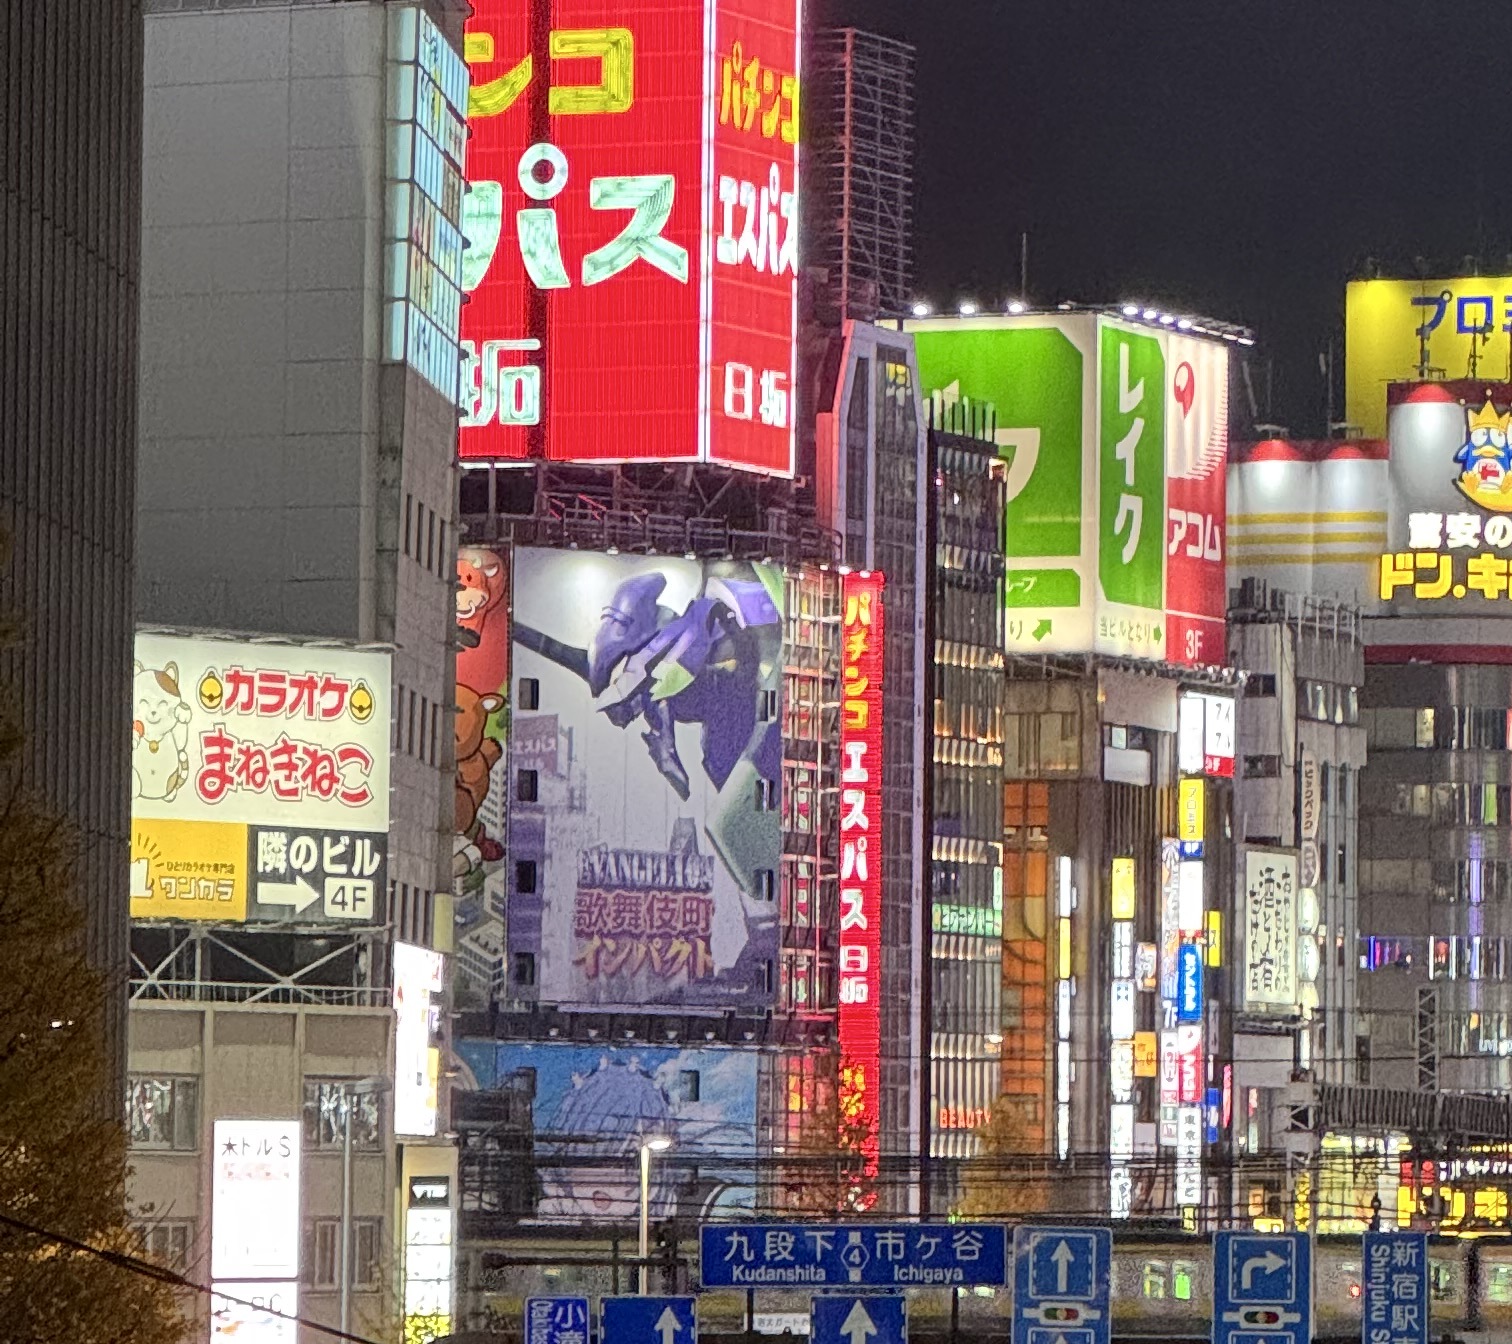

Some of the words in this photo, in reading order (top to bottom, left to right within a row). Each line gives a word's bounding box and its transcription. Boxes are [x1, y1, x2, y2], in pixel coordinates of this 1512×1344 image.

[720, 41, 799, 144] パチンコ
[716, 161, 799, 276] エスパス
[724, 361, 787, 428] 日拓
[1113, 342, 1146, 565] レイク
[1168, 507, 1222, 562] アコム
[842, 587, 875, 730] パチンコ
[1185, 629, 1204, 659] 3F
[222, 665, 349, 719] カラオケ
[198, 727, 371, 802] まねきねこ
[256, 832, 381, 876] 隣のビル
[839, 742, 869, 932] エスパス
[159, 876, 236, 902] ワンカラ
[331, 885, 368, 913] 4F
[576, 892, 713, 933] 歌舞伎町
[572, 934, 715, 979] インパクト
[724, 1230, 836, 1262] 九段下
[847, 1245, 863, 1265] 4
[731, 1264, 827, 1282] Kudanshita
[893, 1264, 964, 1284] Ichigaya
[1367, 1244, 1391, 1323] Shinjuku
